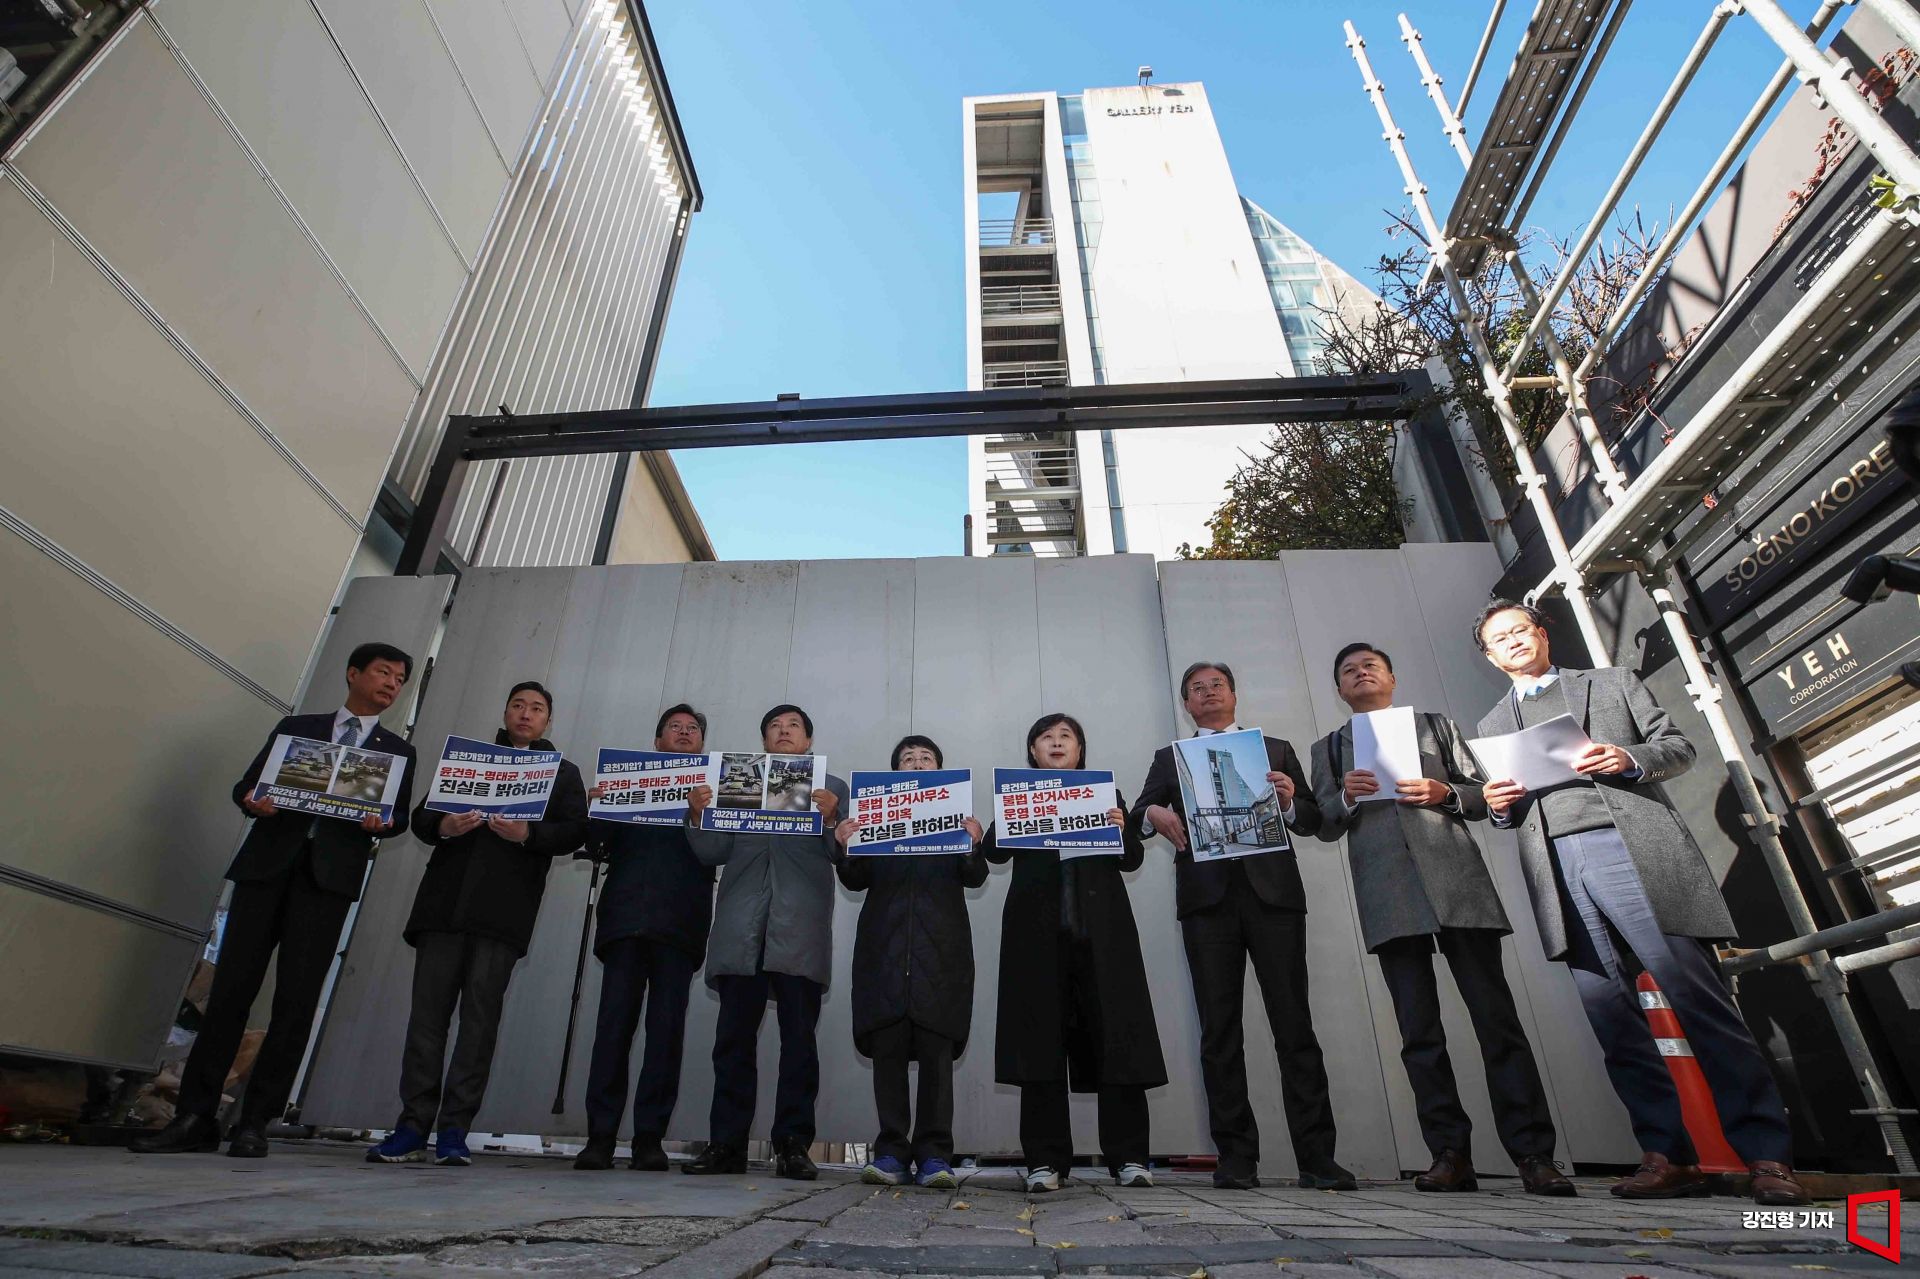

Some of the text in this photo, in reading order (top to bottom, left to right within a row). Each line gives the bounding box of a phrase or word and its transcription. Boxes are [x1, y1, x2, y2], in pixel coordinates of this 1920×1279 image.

[1777, 632, 1851, 690] YEH
[1790, 658, 1858, 705] CORPORATION
[449, 751, 554, 764] 공천개입? 불법 여론조사?
[603, 757, 702, 772] 공천개입? 불법 여론조사?
[440, 767, 555, 781] 윤건희-명태균 게이트
[598, 773, 706, 791] 윤건희-명태균 게이트
[267, 786, 318, 800] 2022년 당시
[439, 780, 548, 797] 진실을 밝혀라!
[858, 780, 918, 797] 윤건희-명태균
[1001, 779, 1062, 793] 윤건희-명태균
[600, 791, 646, 805] 진실을
[858, 788, 950, 812] 불법 선거사무소
[1003, 787, 1094, 806] 불법 선거사무소
[305, 801, 337, 813] 사무실
[338, 807, 358, 817] 내부
[712, 810, 755, 819] 2022년 당시
[858, 808, 912, 826] 운영 의혹
[1004, 805, 1058, 820] 운영 의혹
[746, 821, 772, 831] 사무실
[775, 822, 792, 831] 내부
[795, 822, 813, 832] 사진
[859, 822, 906, 843] 진실을
[1007, 818, 1054, 836] 진실을
